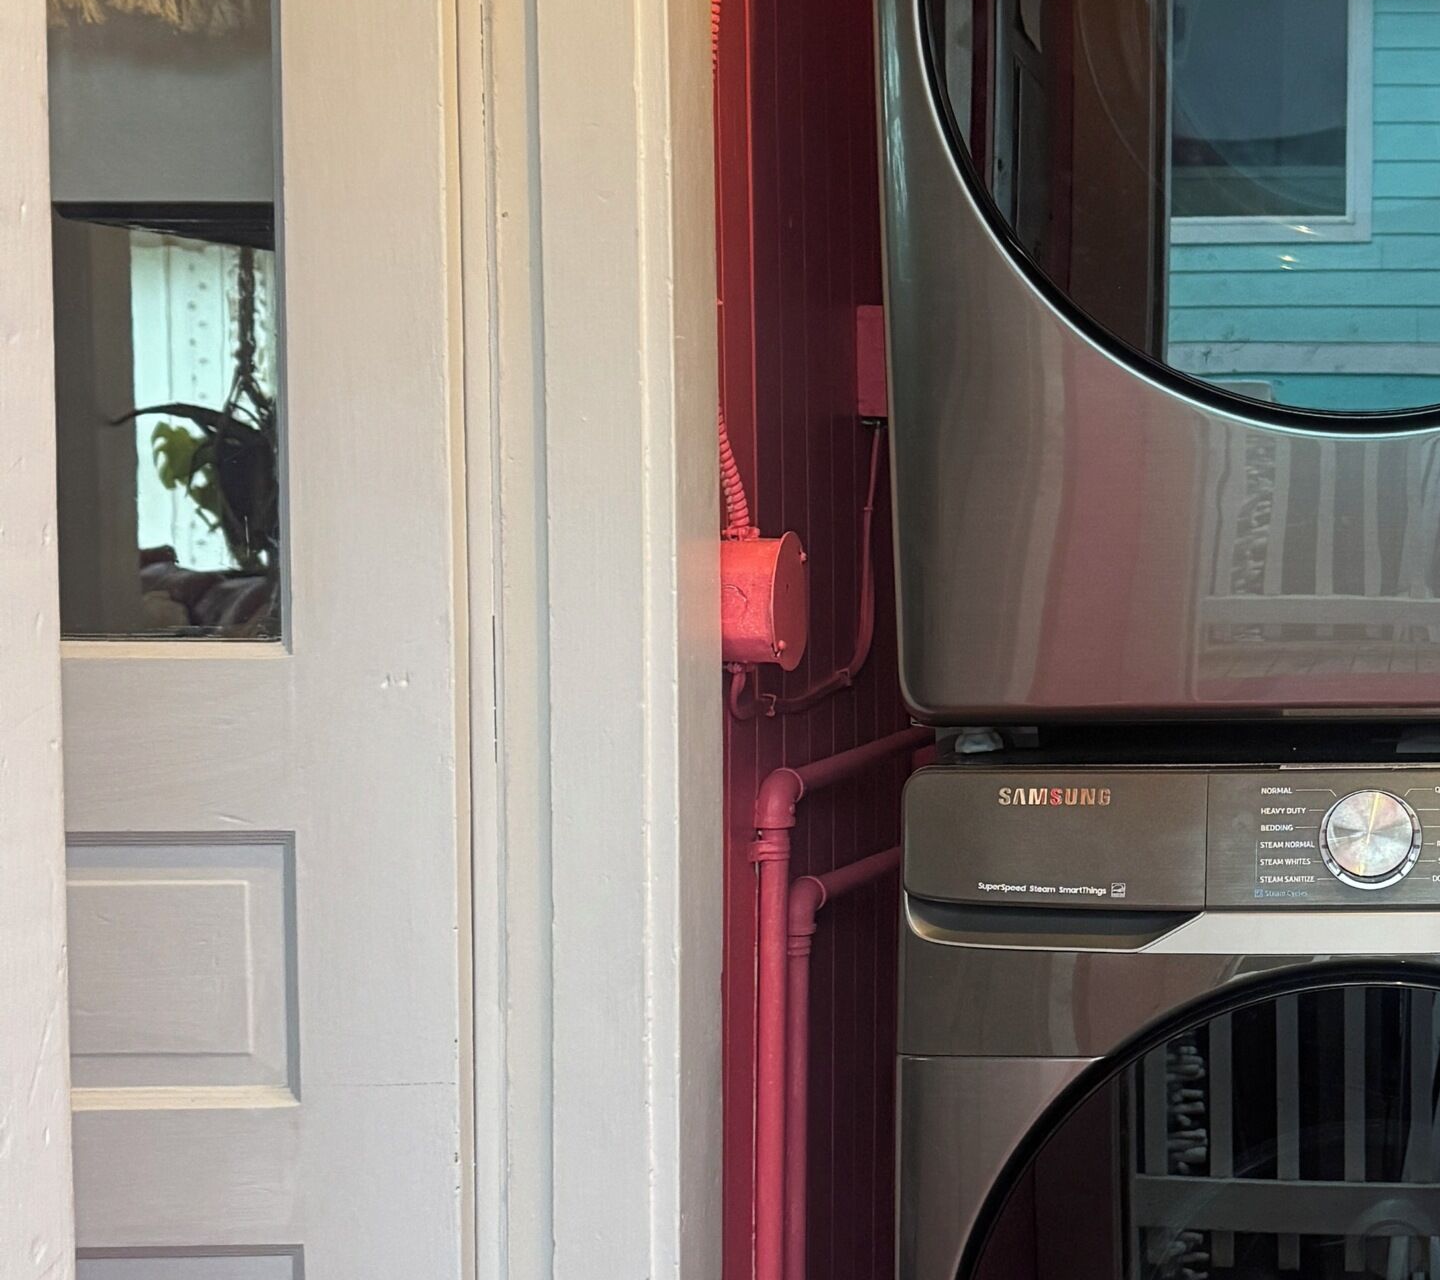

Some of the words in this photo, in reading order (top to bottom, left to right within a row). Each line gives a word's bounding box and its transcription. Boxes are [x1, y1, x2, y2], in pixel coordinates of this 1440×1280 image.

[998, 787, 1111, 806] SAMSUNG
[1260, 807, 1285, 815] HEAVY
[1260, 824, 1294, 832] BEDDING
[1260, 841, 1284, 849] STEAM
[1259, 858, 1283, 866] STEAM
[1259, 875, 1283, 883] STEAM
[1284, 875, 1316, 883] SANITIZE
[977, 882, 1027, 893] SuperSpeed
[1029, 884, 1057, 893] Steam
[1058, 886, 1107, 897] SmartThings
